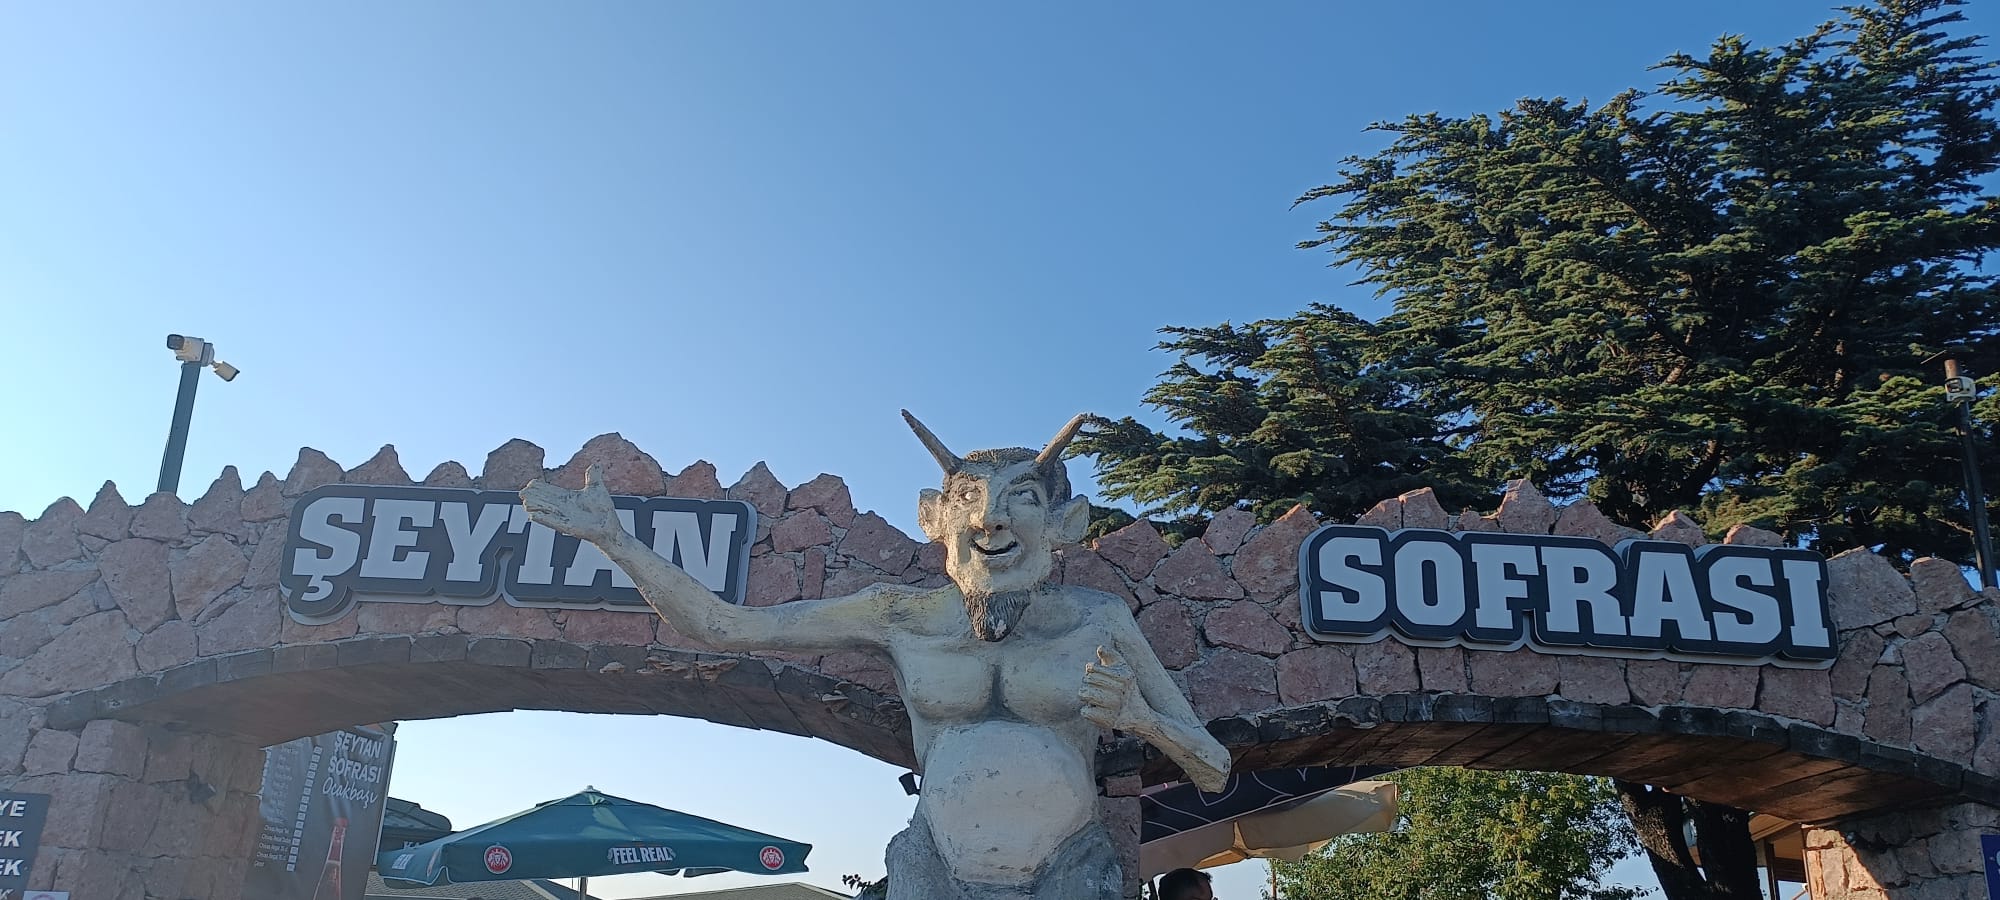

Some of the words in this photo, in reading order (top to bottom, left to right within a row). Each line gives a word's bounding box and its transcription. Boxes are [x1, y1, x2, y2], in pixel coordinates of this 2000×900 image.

[292, 496, 738, 602] ŞEYTAN
[1318, 535, 1831, 648] SOFRASI
[334, 730, 382, 757] ŞEYTAN
[327, 755, 382, 783] SOFRASI
[322, 777, 378, 808] Ocakbaşı
[611, 847, 640, 865] FEEL
[640, 846, 674, 863] REAL
